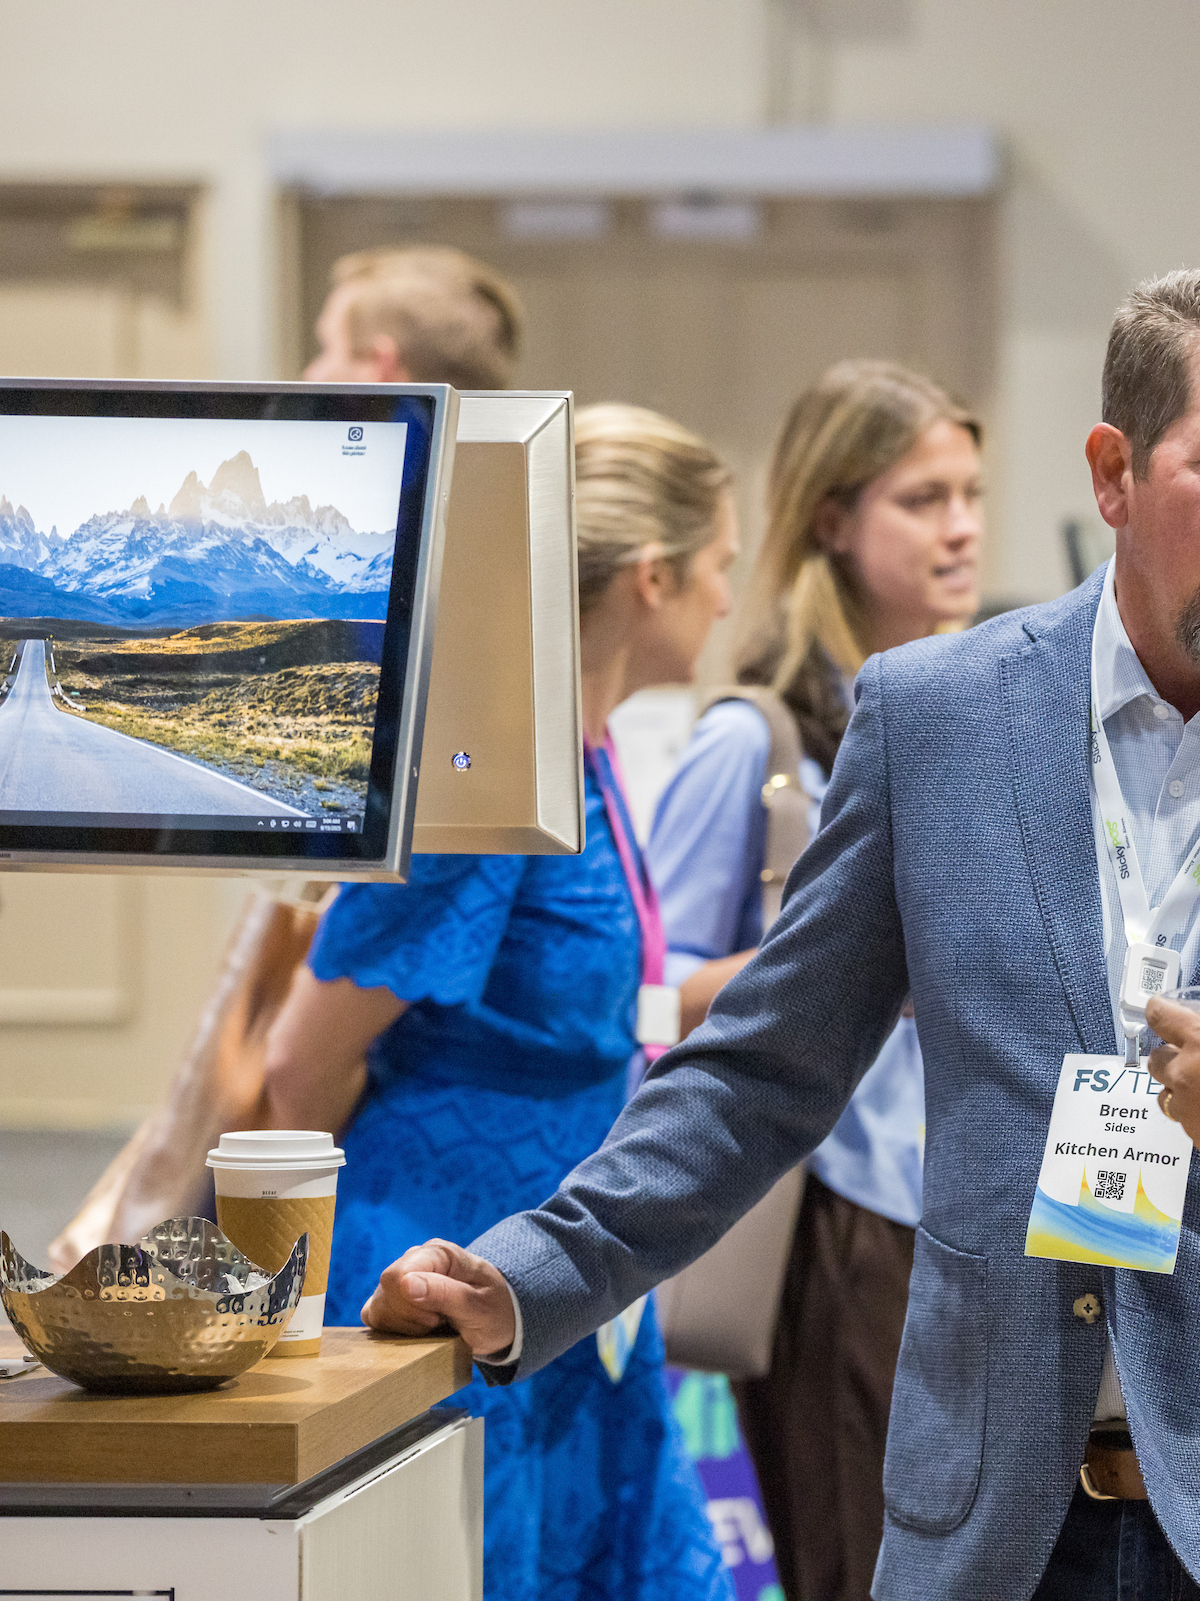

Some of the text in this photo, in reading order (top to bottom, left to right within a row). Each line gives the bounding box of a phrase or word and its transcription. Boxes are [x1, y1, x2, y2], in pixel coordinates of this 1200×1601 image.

[1072, 1069, 1162, 1095] FS/TE
[1099, 1104, 1149, 1120] Brent
[1104, 1122, 1136, 1134] Sides
[1054, 1142, 1180, 1167] Kitchen Armor
